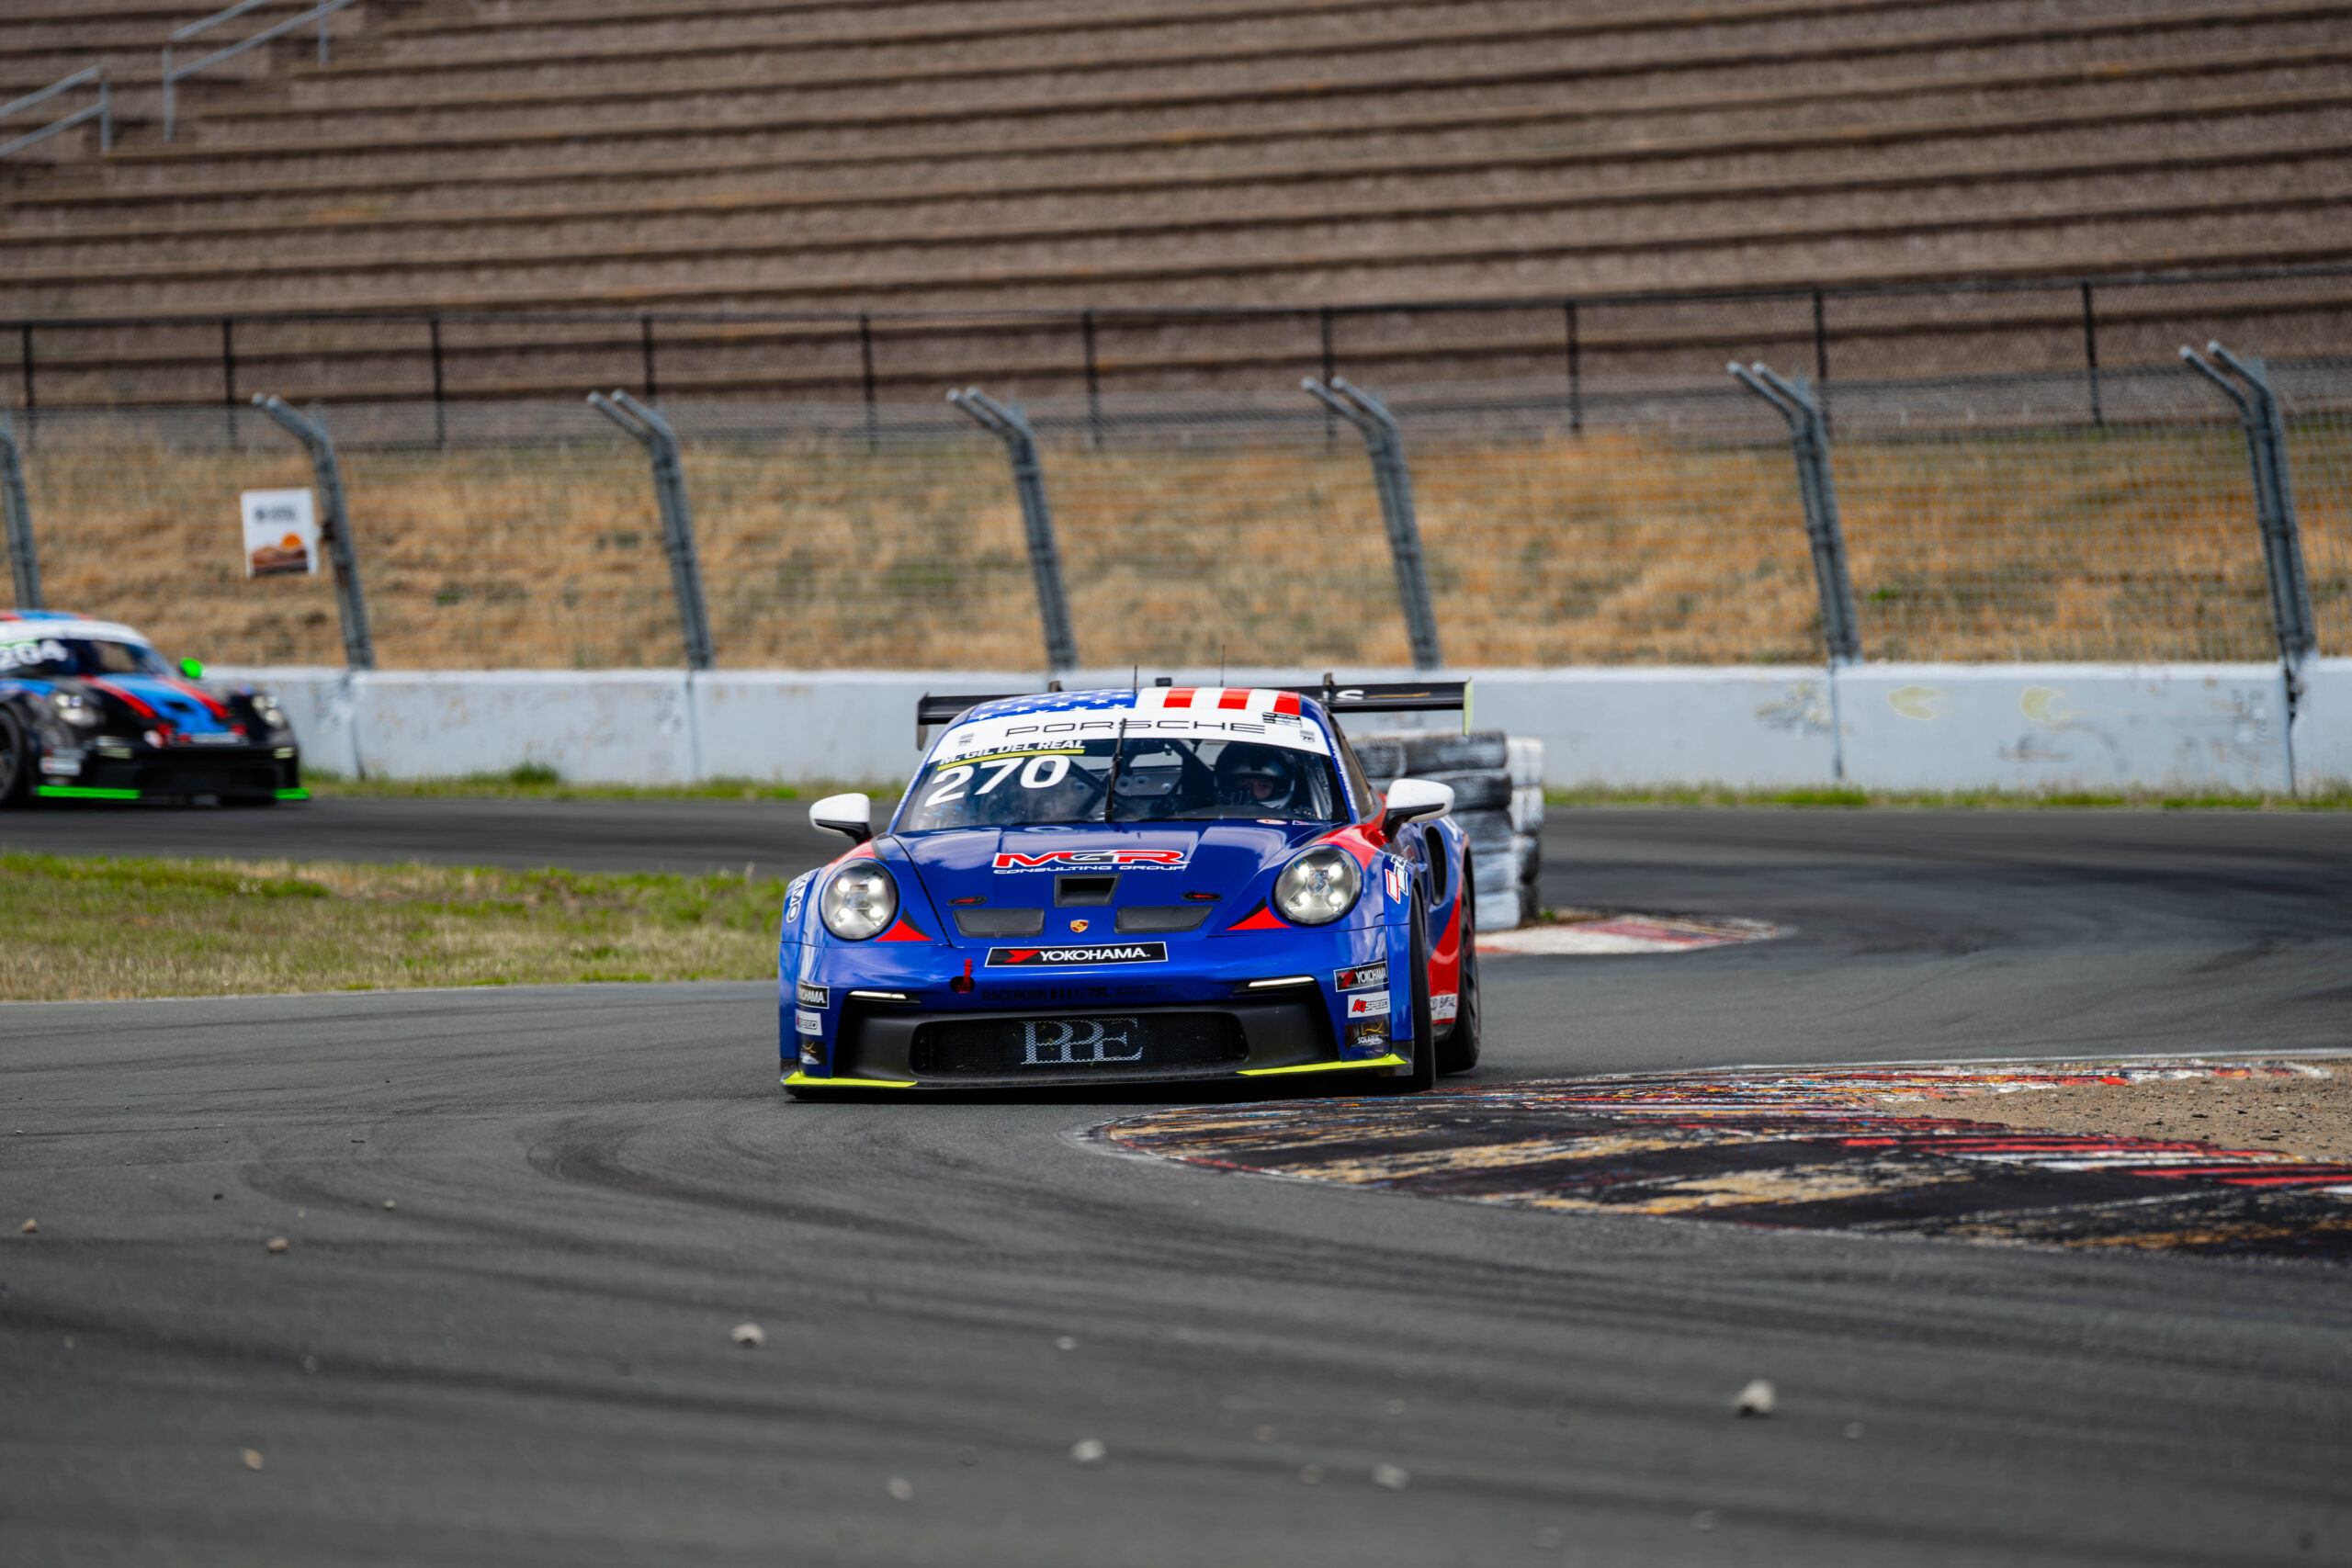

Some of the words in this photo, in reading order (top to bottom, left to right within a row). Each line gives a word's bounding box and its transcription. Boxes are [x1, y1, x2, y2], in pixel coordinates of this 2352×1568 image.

[1004, 719, 1266, 737] PORSCHE
[964, 748, 994, 759] GIL
[996, 742, 1033, 754] DEL
[1036, 739, 1086, 750] REAL
[924, 754, 1071, 807] 270
[991, 849, 1191, 868] MGR
[993, 865, 1113, 874] CONSULTING
[1039, 947, 1148, 962] YOKOHAMA
